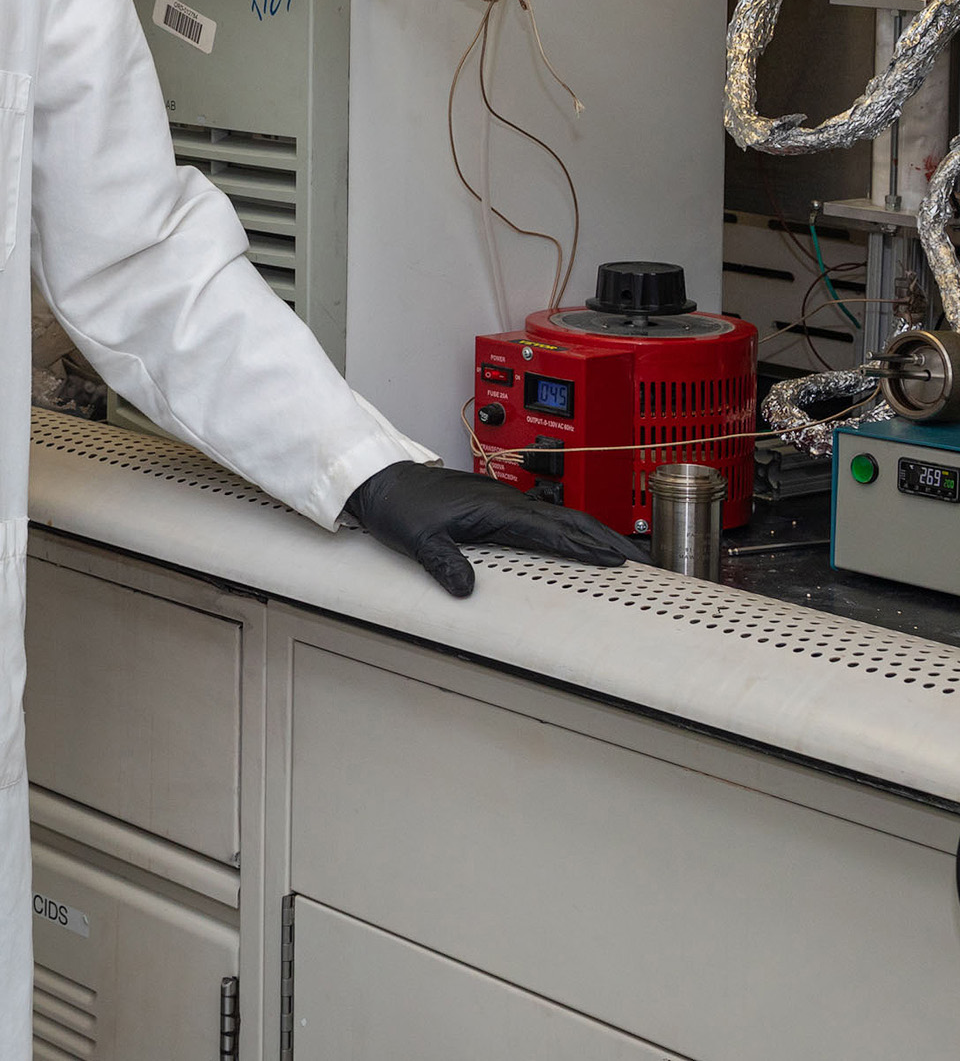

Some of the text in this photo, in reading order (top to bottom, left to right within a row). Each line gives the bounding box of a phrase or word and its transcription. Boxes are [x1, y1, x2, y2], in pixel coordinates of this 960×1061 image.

[490, 353, 506, 363] POWER
[487, 389, 499, 399] FUSE
[919, 466, 941, 487] 269
[32, 894, 69, 926] CIDS
